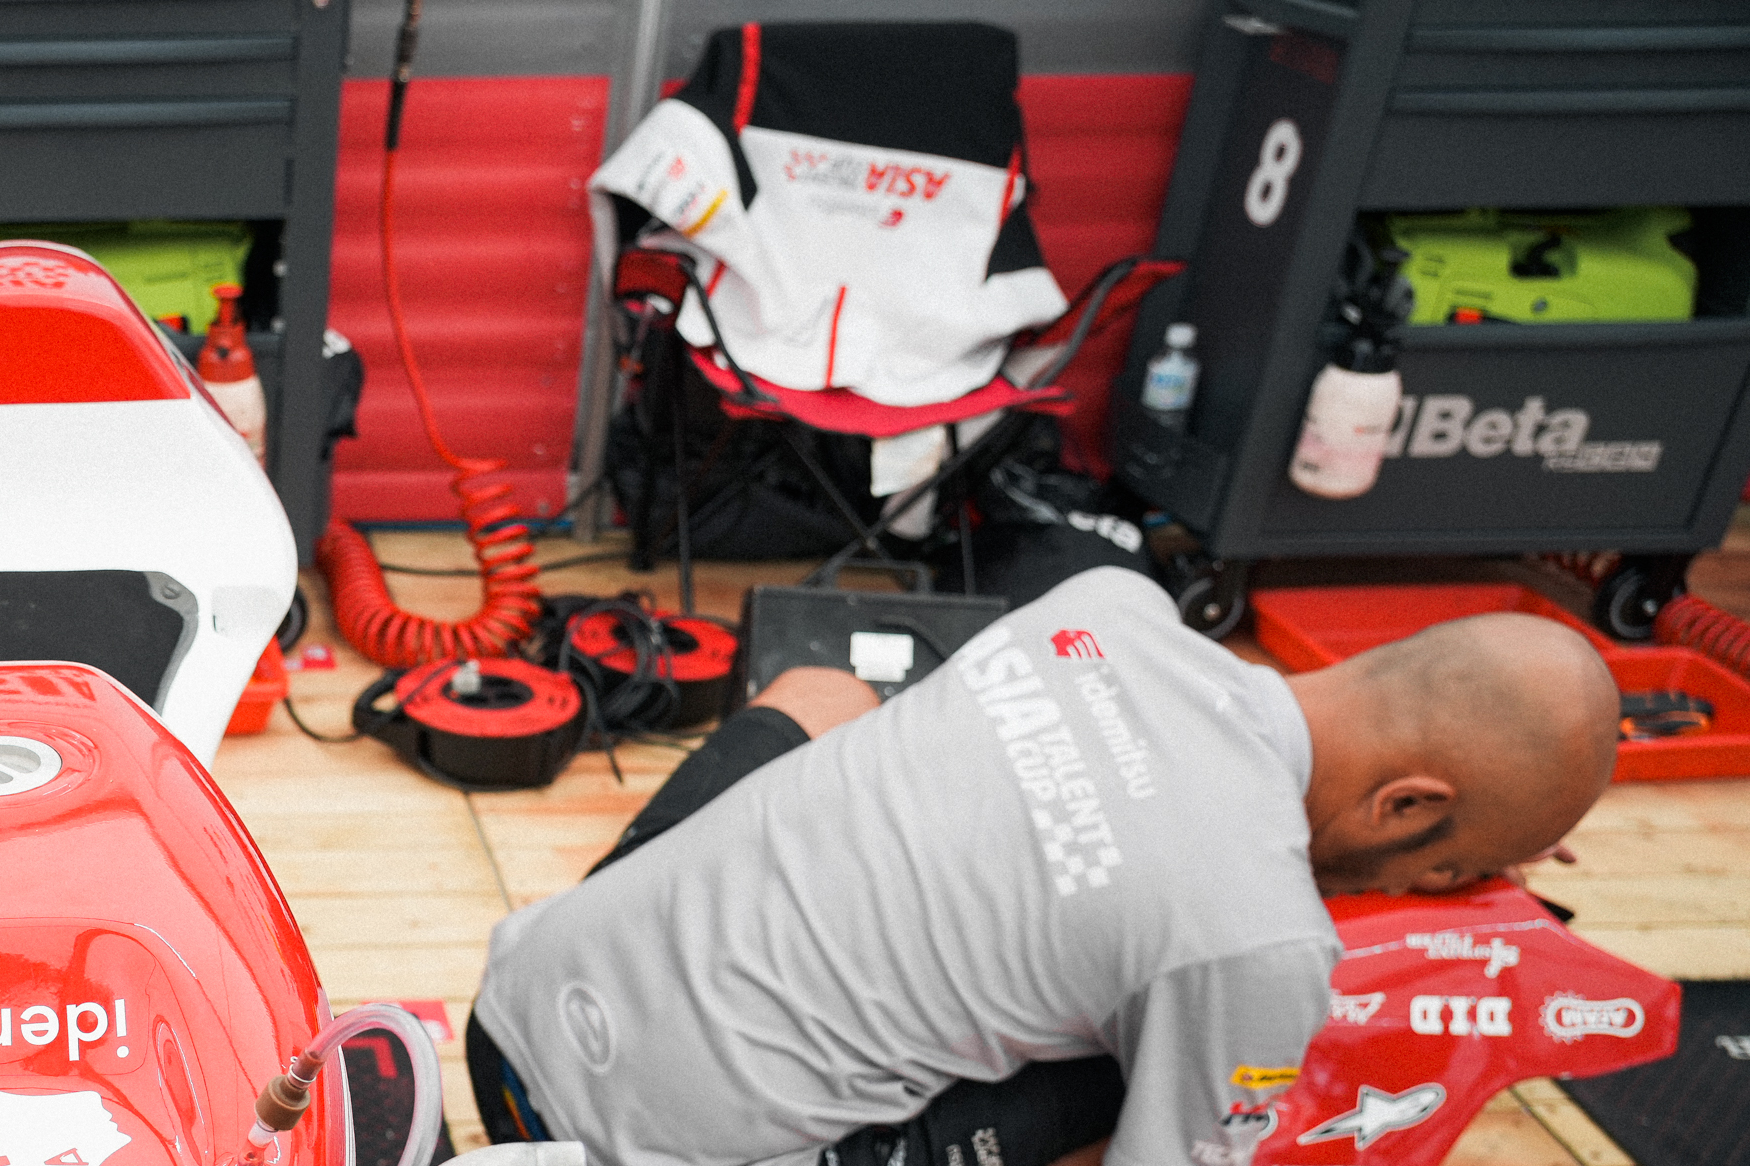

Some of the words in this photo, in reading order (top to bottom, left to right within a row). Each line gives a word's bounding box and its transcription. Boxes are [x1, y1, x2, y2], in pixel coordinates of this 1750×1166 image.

[864, 162, 952, 201] ASIA
[1245, 118, 1303, 227] 8
[1408, 394, 1591, 459] Beta
[1006, 739, 1057, 802] CUP
[1074, 662, 1157, 800] idemitsu
[1037, 724, 1113, 846] TALENT
